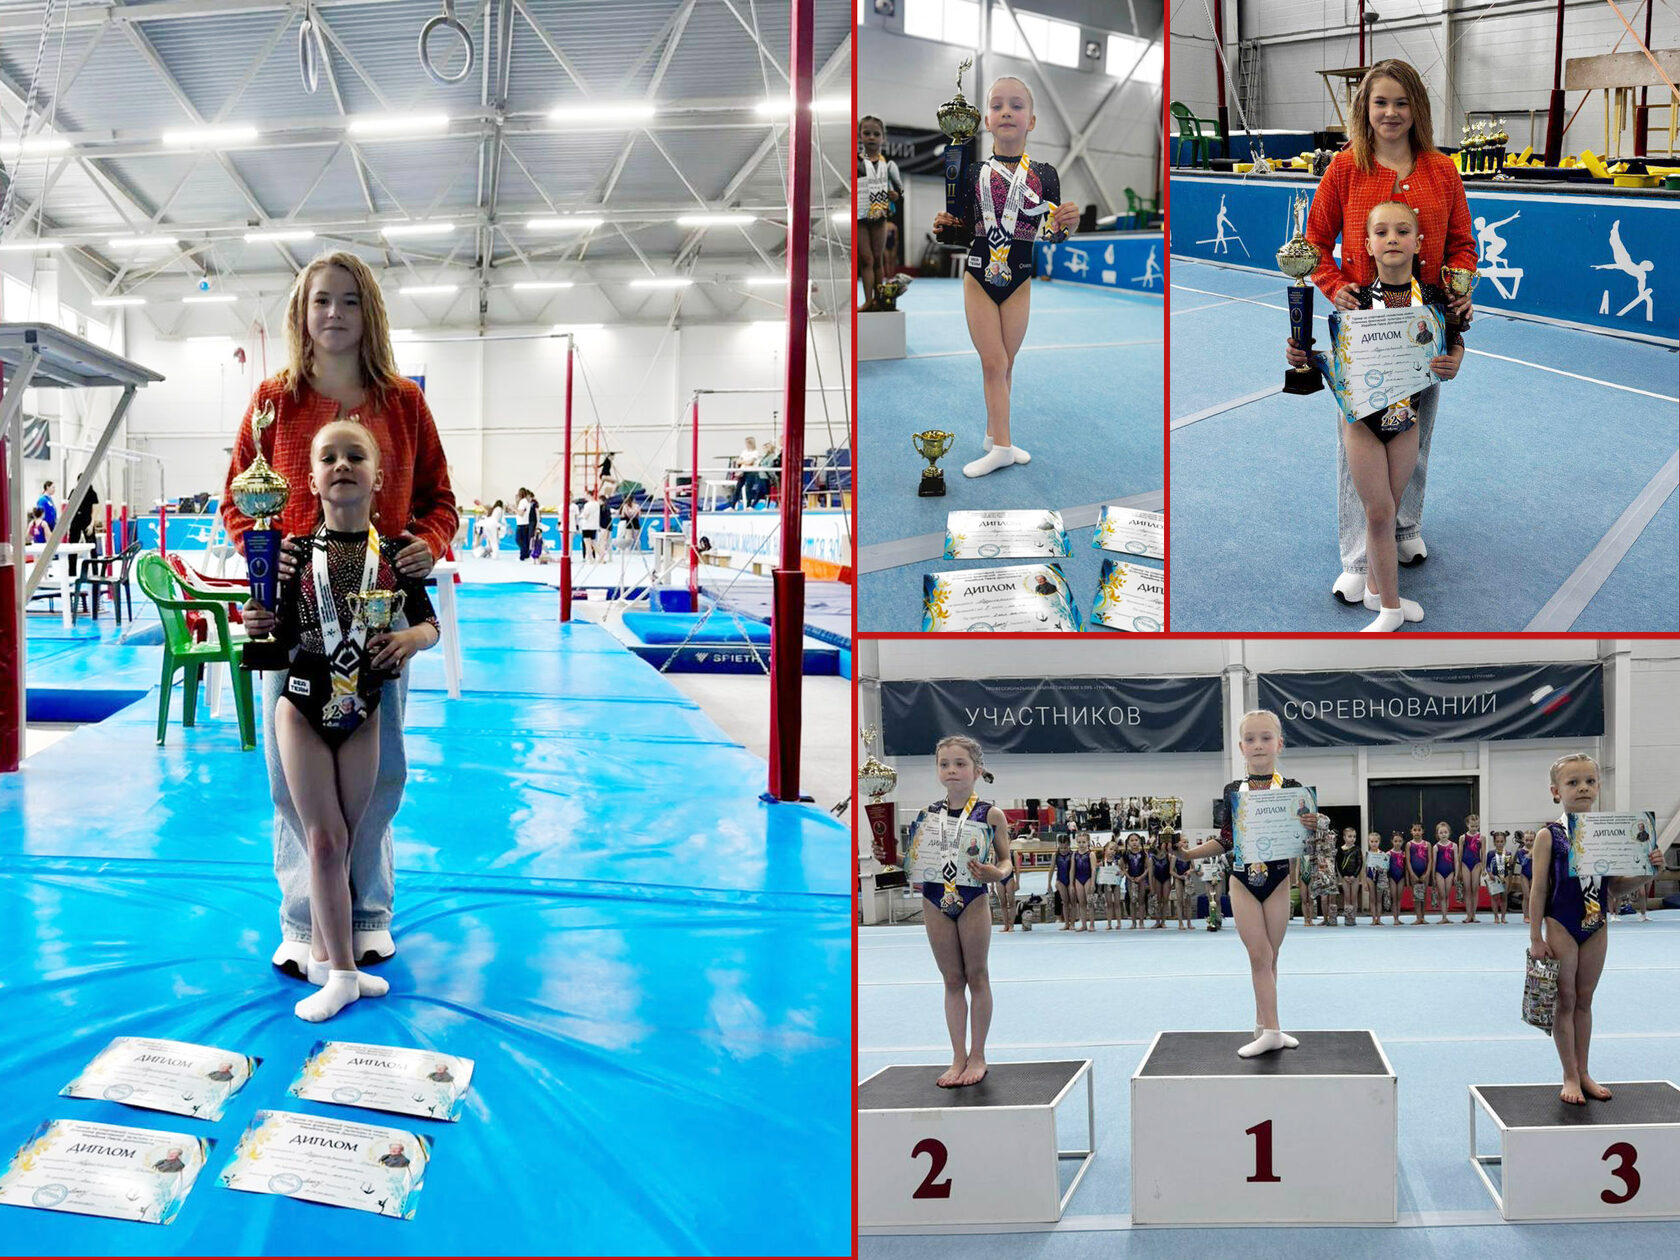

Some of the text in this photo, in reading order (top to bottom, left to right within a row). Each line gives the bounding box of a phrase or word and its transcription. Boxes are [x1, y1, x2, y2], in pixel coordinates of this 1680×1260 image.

[1361, 330, 1402, 344] ДИПЛОМ
[964, 583, 1016, 597] ДИПЛОМ
[1283, 689, 1497, 720] СОРЕВНОВАНИЙ
[965, 706, 1141, 726] УЧАСТНИКОВ
[1255, 806, 1287, 816] ДИПЛОМ
[1593, 829, 1626, 838] ДИПЛОМ
[134, 1054, 193, 1068] ДИПЛОМ
[66, 1143, 137, 1158] ДИПЛОМ
[289, 1134, 358, 1152] ДИПЛОМ
[1245, 1119, 1281, 1182] 1
[911, 1138, 952, 1199] 2
[1600, 1142, 1641, 1204] 3
